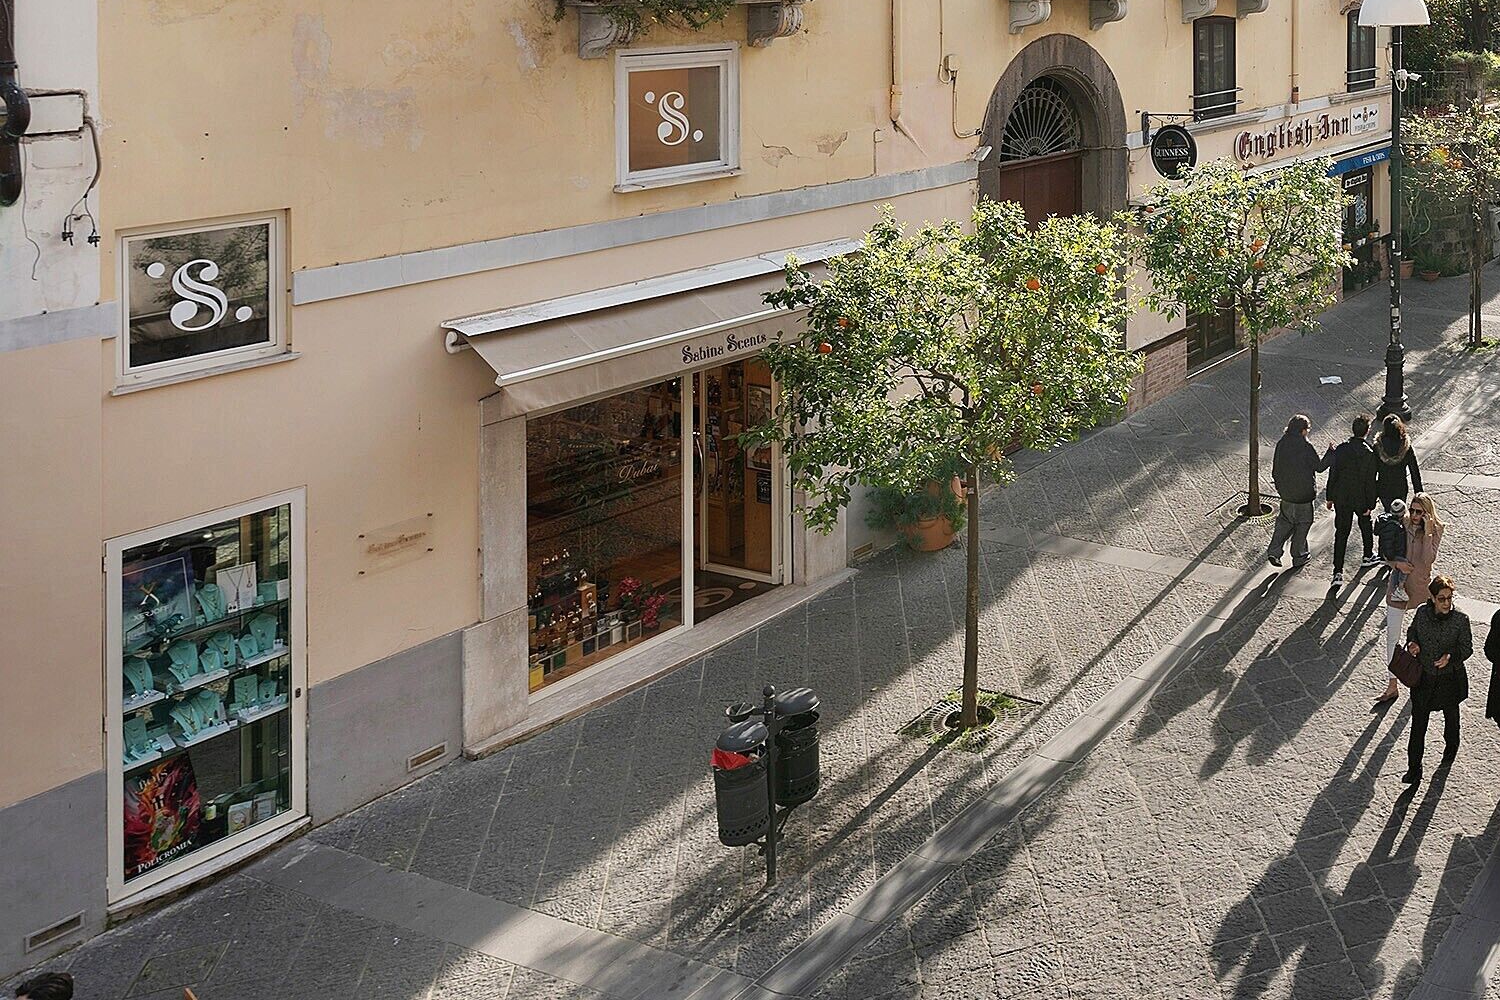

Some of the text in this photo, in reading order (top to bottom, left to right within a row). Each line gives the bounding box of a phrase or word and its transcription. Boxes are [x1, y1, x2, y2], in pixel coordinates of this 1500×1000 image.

[1154, 147, 1189, 157] GUINNESS
[1234, 113, 1349, 161] English Inn
[682, 334, 767, 364] Sabina Scents
[137, 839, 192, 873] POLICROMIA
